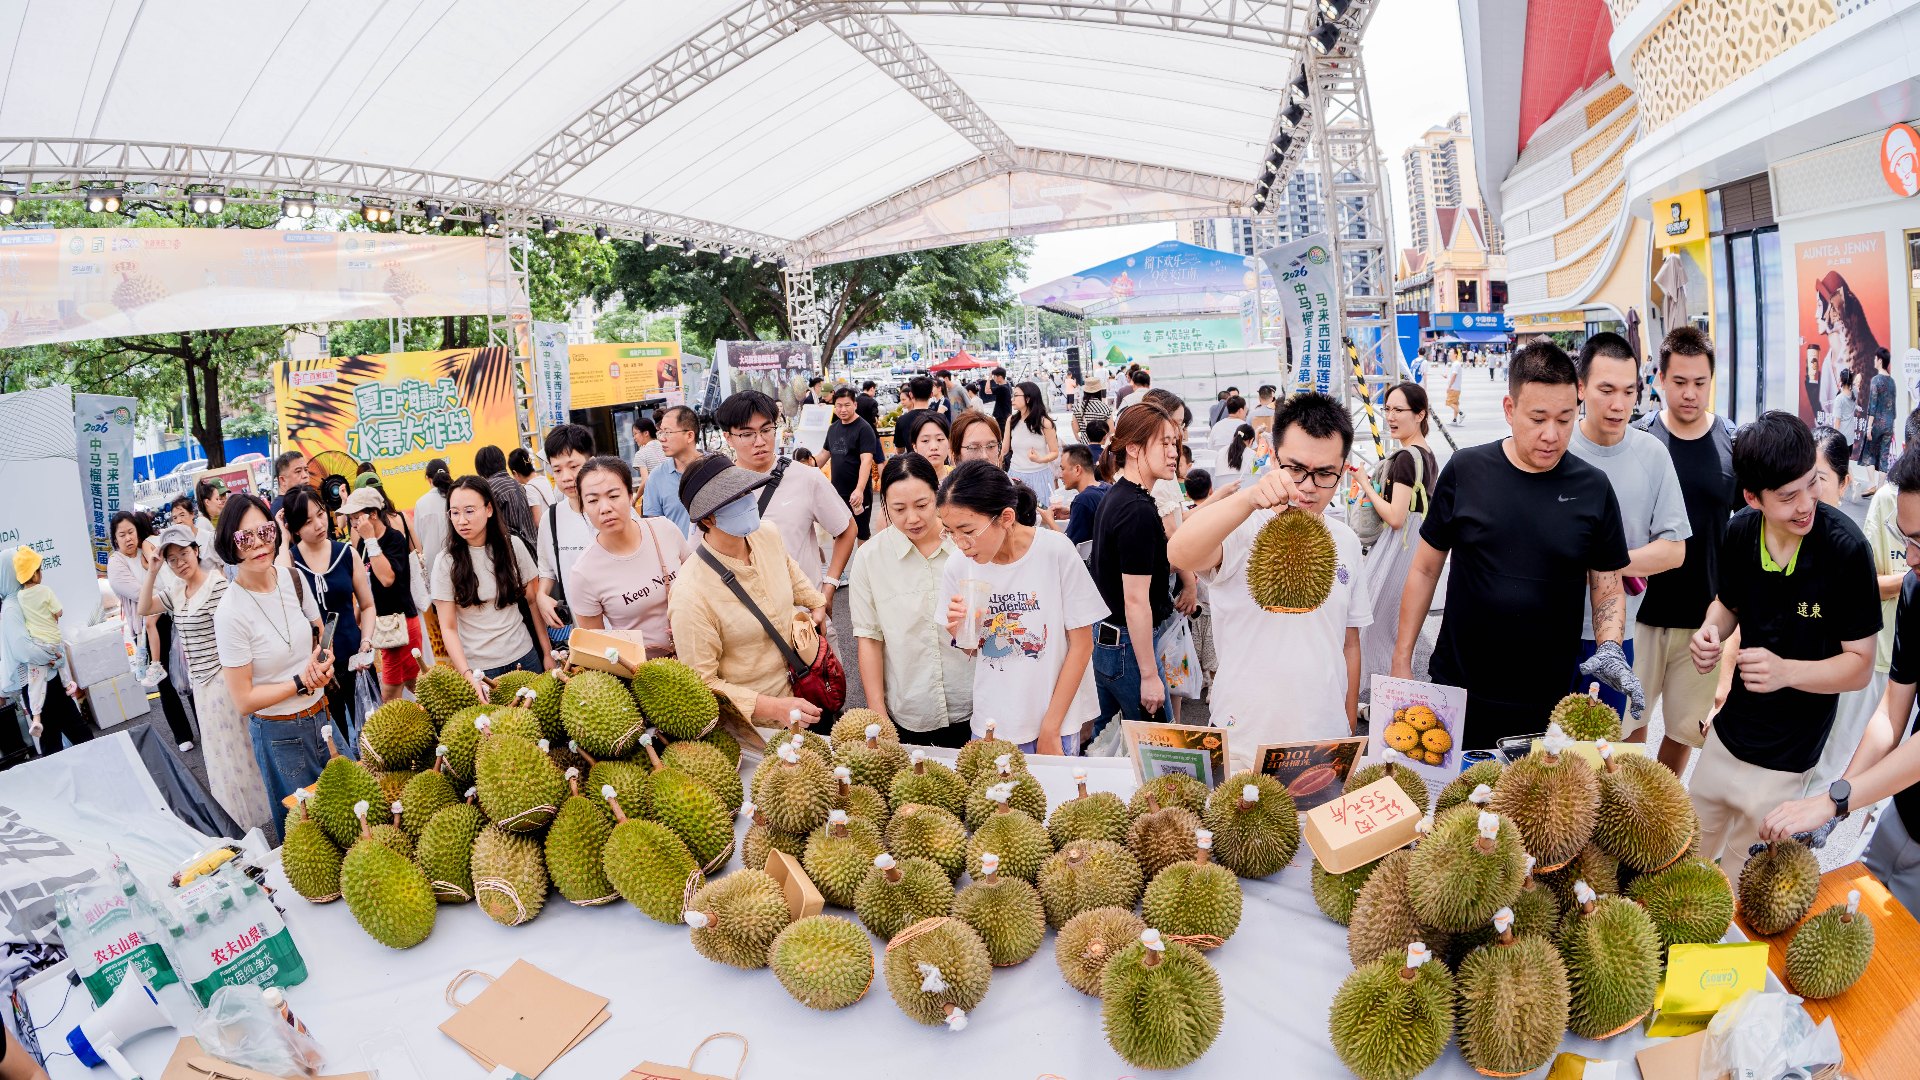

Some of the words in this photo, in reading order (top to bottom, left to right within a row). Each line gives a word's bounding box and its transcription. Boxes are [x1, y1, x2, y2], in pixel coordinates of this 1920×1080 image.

[1803, 245, 1840, 259] AUNTEA
[1844, 239, 1877, 254] JENNY
[1282, 265, 1308, 282] 2026
[356, 380, 459, 420] 夏日嗨翻天
[83, 421, 109, 434] 2026
[347, 410, 473, 462] 水果大作战
[0, 528, 20, 542] DA)
[41, 555, 62, 571] 院校
[621, 585, 650, 606] Keep
[1017, 591, 1028, 602] in
[988, 600, 1041, 615] nderland
[1796, 601, 1823, 618] 遠東
[1270, 750, 1310, 762] D101
[94, 932, 141, 965] 农夫山泉
[211, 925, 262, 966] 农夫山泉
